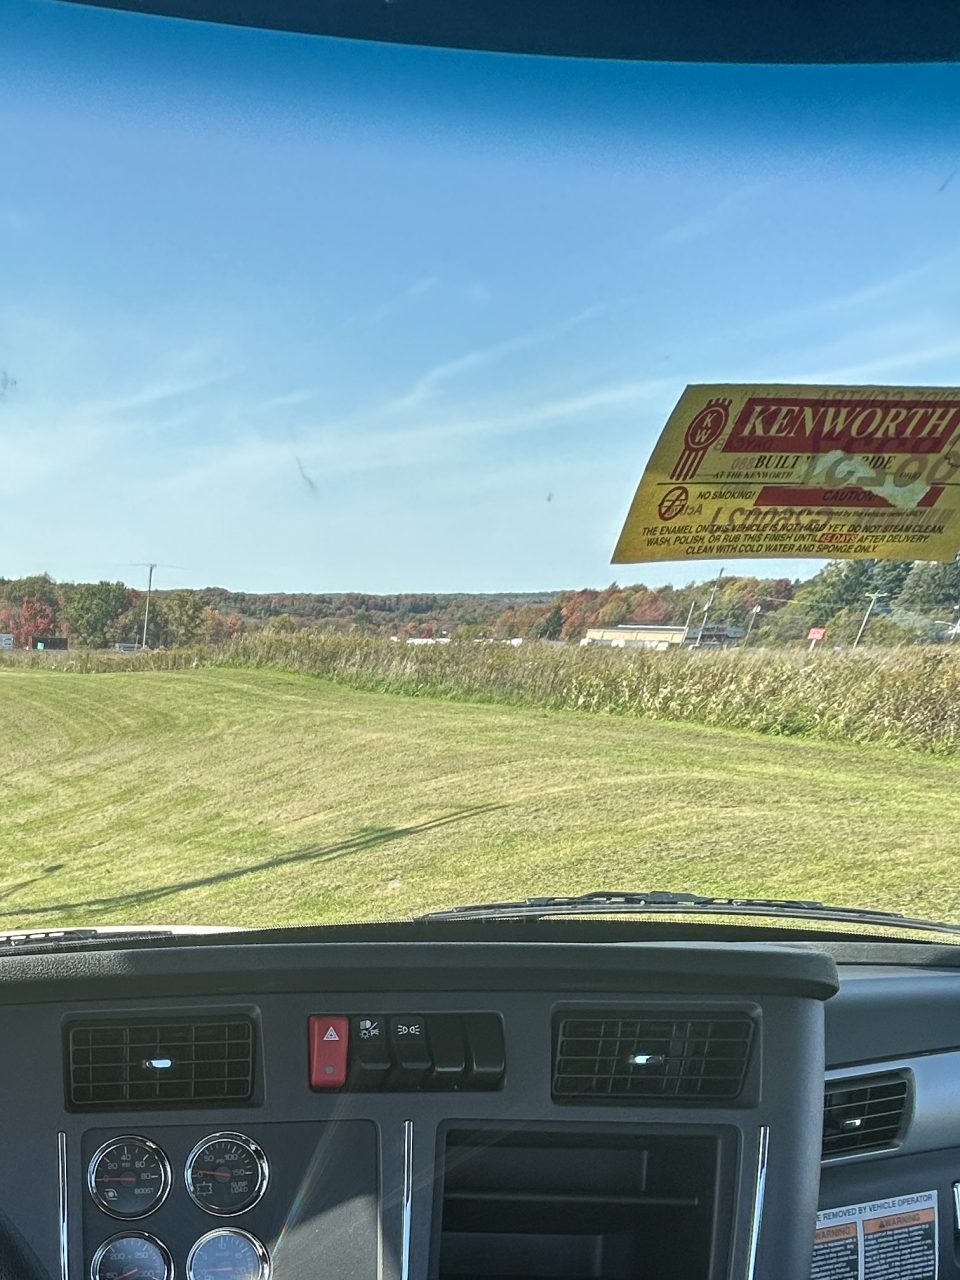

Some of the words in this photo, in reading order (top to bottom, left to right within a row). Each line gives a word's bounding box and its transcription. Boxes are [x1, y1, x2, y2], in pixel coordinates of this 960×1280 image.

[702, 413, 716, 427] K
[740, 405, 959, 439] KENWORTH
[695, 429, 711, 442] W
[754, 455, 801, 469] BUILT
[712, 491, 756, 499] SMOKING!
[642, 527, 658, 536] THE
[660, 525, 693, 535] ENAMEL
[696, 525, 709, 533] ON
[731, 524, 771, 532] VEHICLE
[780, 524, 799, 532] NOT
[801, 524, 826, 532] HARD
[828, 524, 845, 532] YET.
[848, 524, 862, 533] DO
[863, 525, 882, 533] NOT
[882, 525, 912, 533] STEAM
[708, 535, 721, 543] OR
[723, 534, 740, 542] RUB
[743, 534, 761, 542] THIS
[763, 533, 791, 541] FINISH
[794, 533, 818, 541] UNTIL
[834, 534, 857, 543] DAYS
[857, 535, 885, 543] AFTER
[686, 546, 716, 555] CLEAN
[717, 545, 738, 553] WITH
[740, 544, 763, 552] COLD
[766, 544, 794, 552] WATER
[796, 544, 814, 552] AND
[816, 544, 853, 553] SPONGE
[121, 1153, 132, 1161] 40
[224, 1153, 238, 1161] 100
[107, 1162, 118, 1170] 20
[822, 1209, 857, 1220] REMOVED
[858, 1206, 867, 1214] BY
[868, 1200, 897, 1212] VEHICLE
[897, 1194, 933, 1207] OPERATOR
[884, 1213, 921, 1228] WARNING
